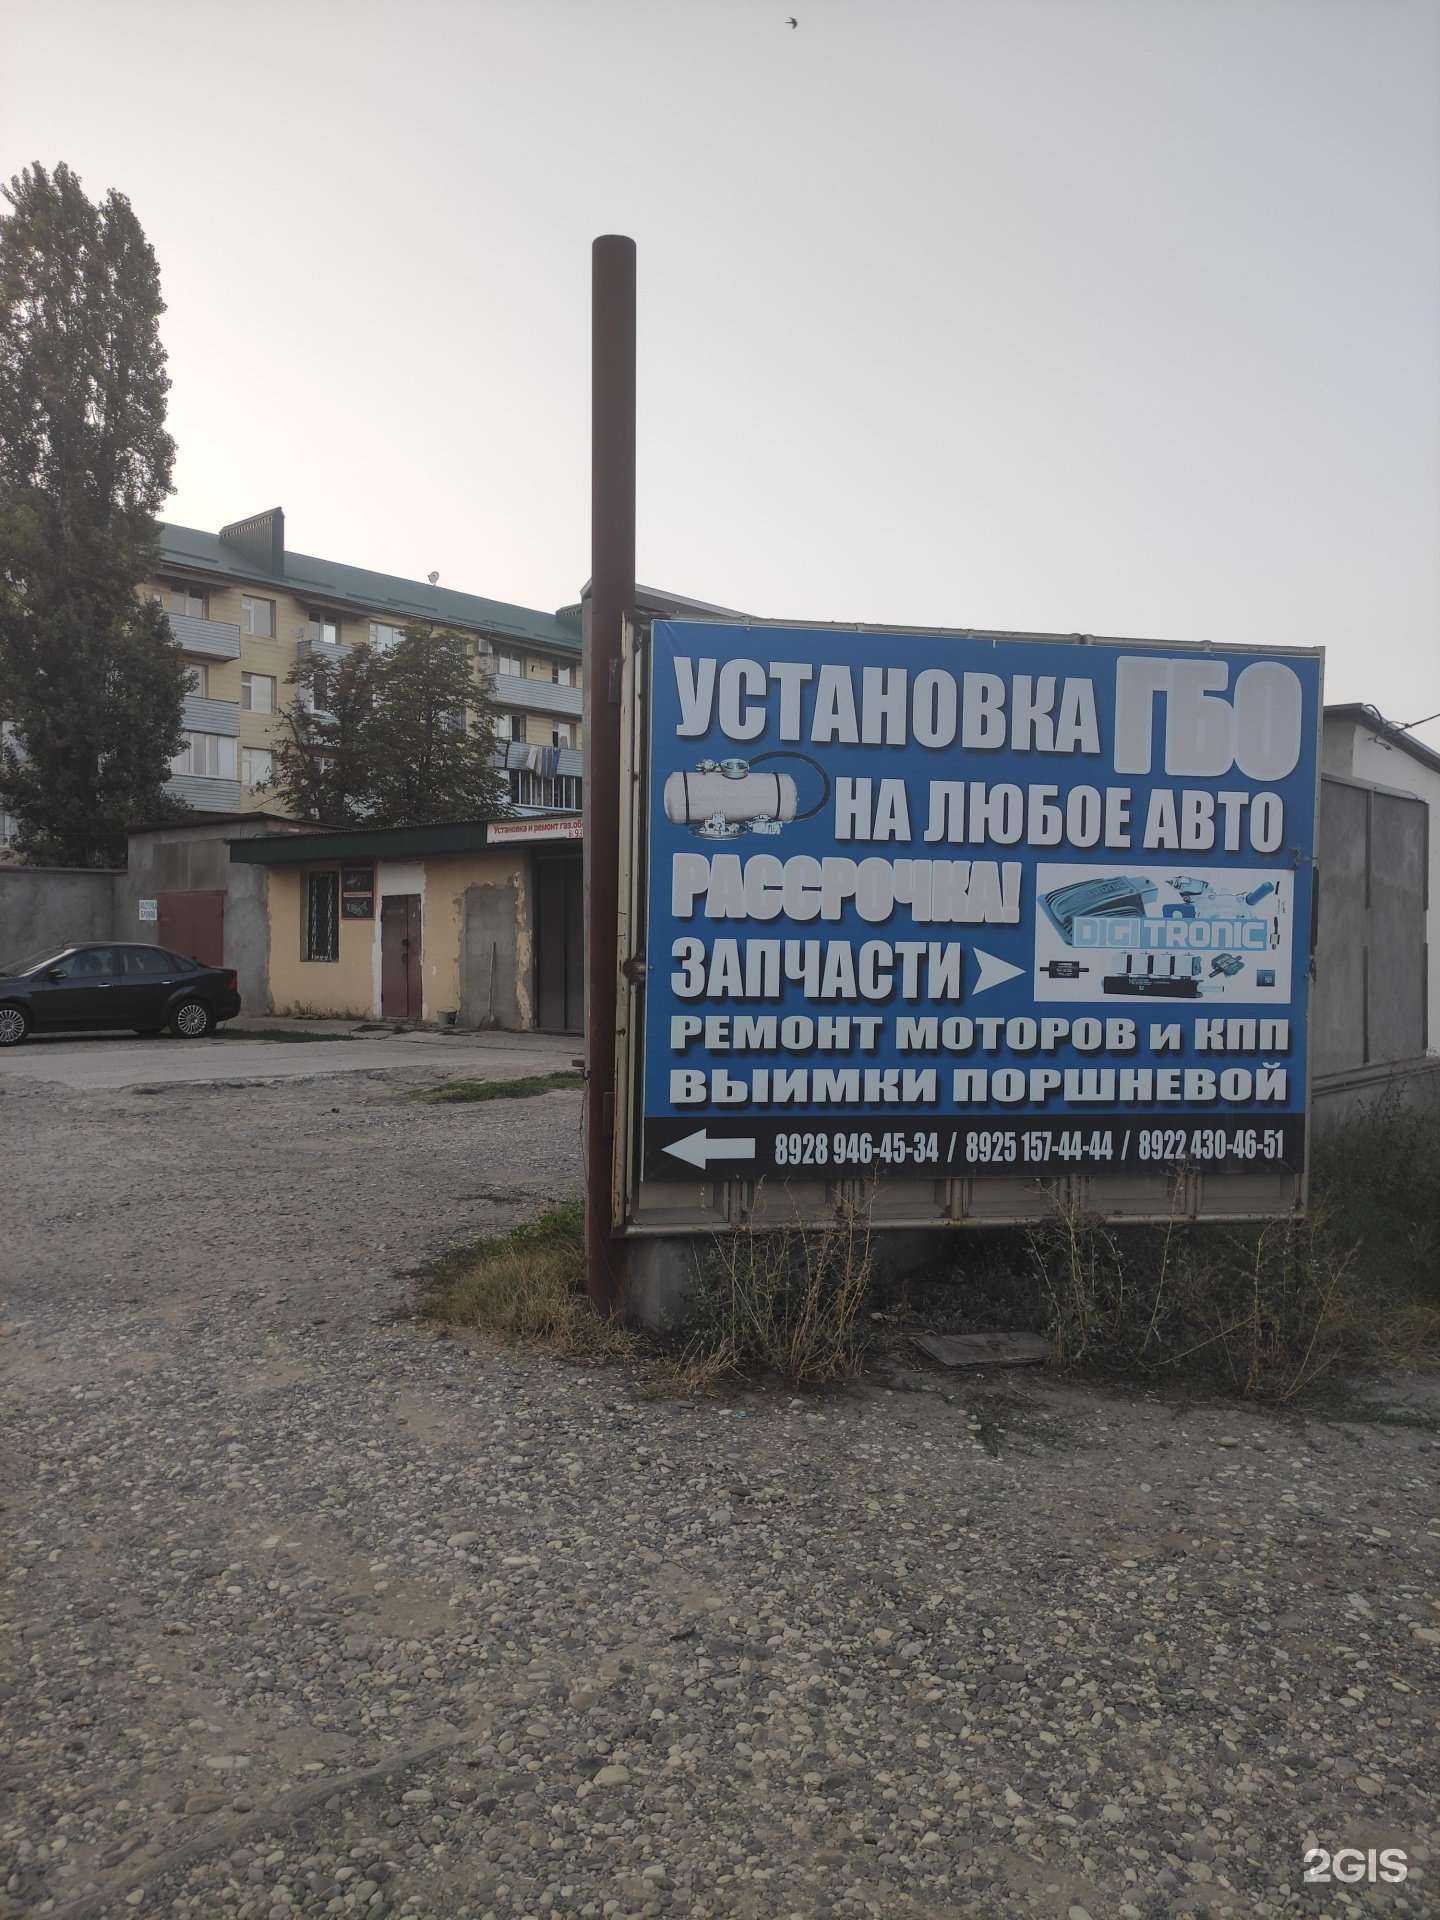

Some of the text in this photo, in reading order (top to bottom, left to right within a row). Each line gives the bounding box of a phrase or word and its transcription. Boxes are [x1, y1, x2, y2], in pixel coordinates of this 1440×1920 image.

[673, 655, 1302, 782] УСТАНОВКА ГБО
[834, 776, 1284, 853] НА ЛЮБОЕ АВТО
[672, 853, 1022, 924] РАССРОЧКА!
[1074, 918, 1268, 950] DIGITRONIC
[671, 937, 961, 999] ЗАПЧАСТИ
[670, 1016, 1289, 1050] РЕМОНТ МОТОРОВ и КПП
[670, 1062, 1287, 1103] ВЫИМКИ ПОРШНЕВОЙ
[774, 1134, 828, 1165] 8928
[833, 1133, 938, 1164] 946-45-34
[966, 1132, 1017, 1163] 8925
[1021, 1131, 1113, 1162] 157-44-44
[1139, 1129, 1187, 1161] 8922
[1190, 1129, 1284, 1160] 430-46-51
